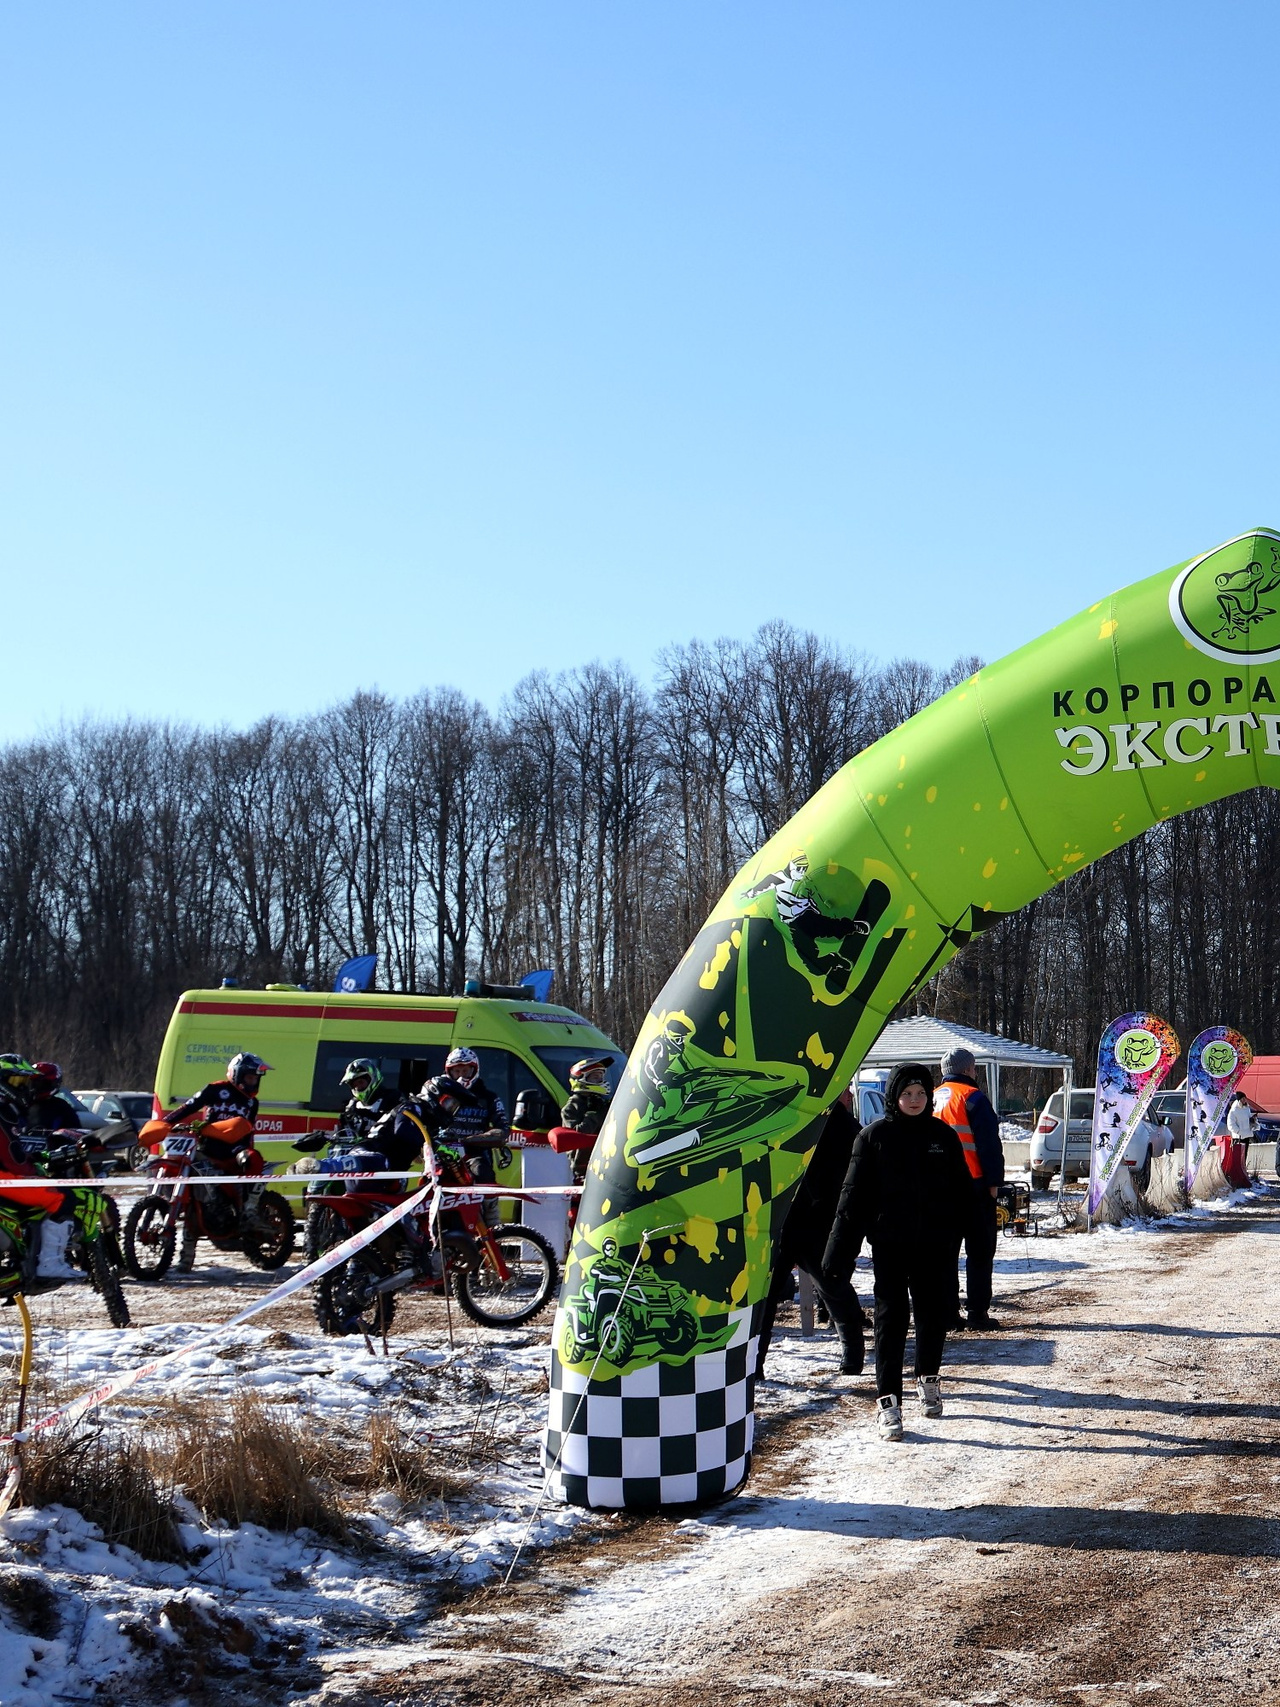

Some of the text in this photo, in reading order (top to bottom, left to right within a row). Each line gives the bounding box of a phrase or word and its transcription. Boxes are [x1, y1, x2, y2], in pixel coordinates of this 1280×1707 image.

[457, 1108, 489, 1117] ANTIS
[255, 1120, 283, 1131] ОРАЯ
[167, 1138, 193, 1152] 741
[410, 1193, 485, 1216] ASGAS
